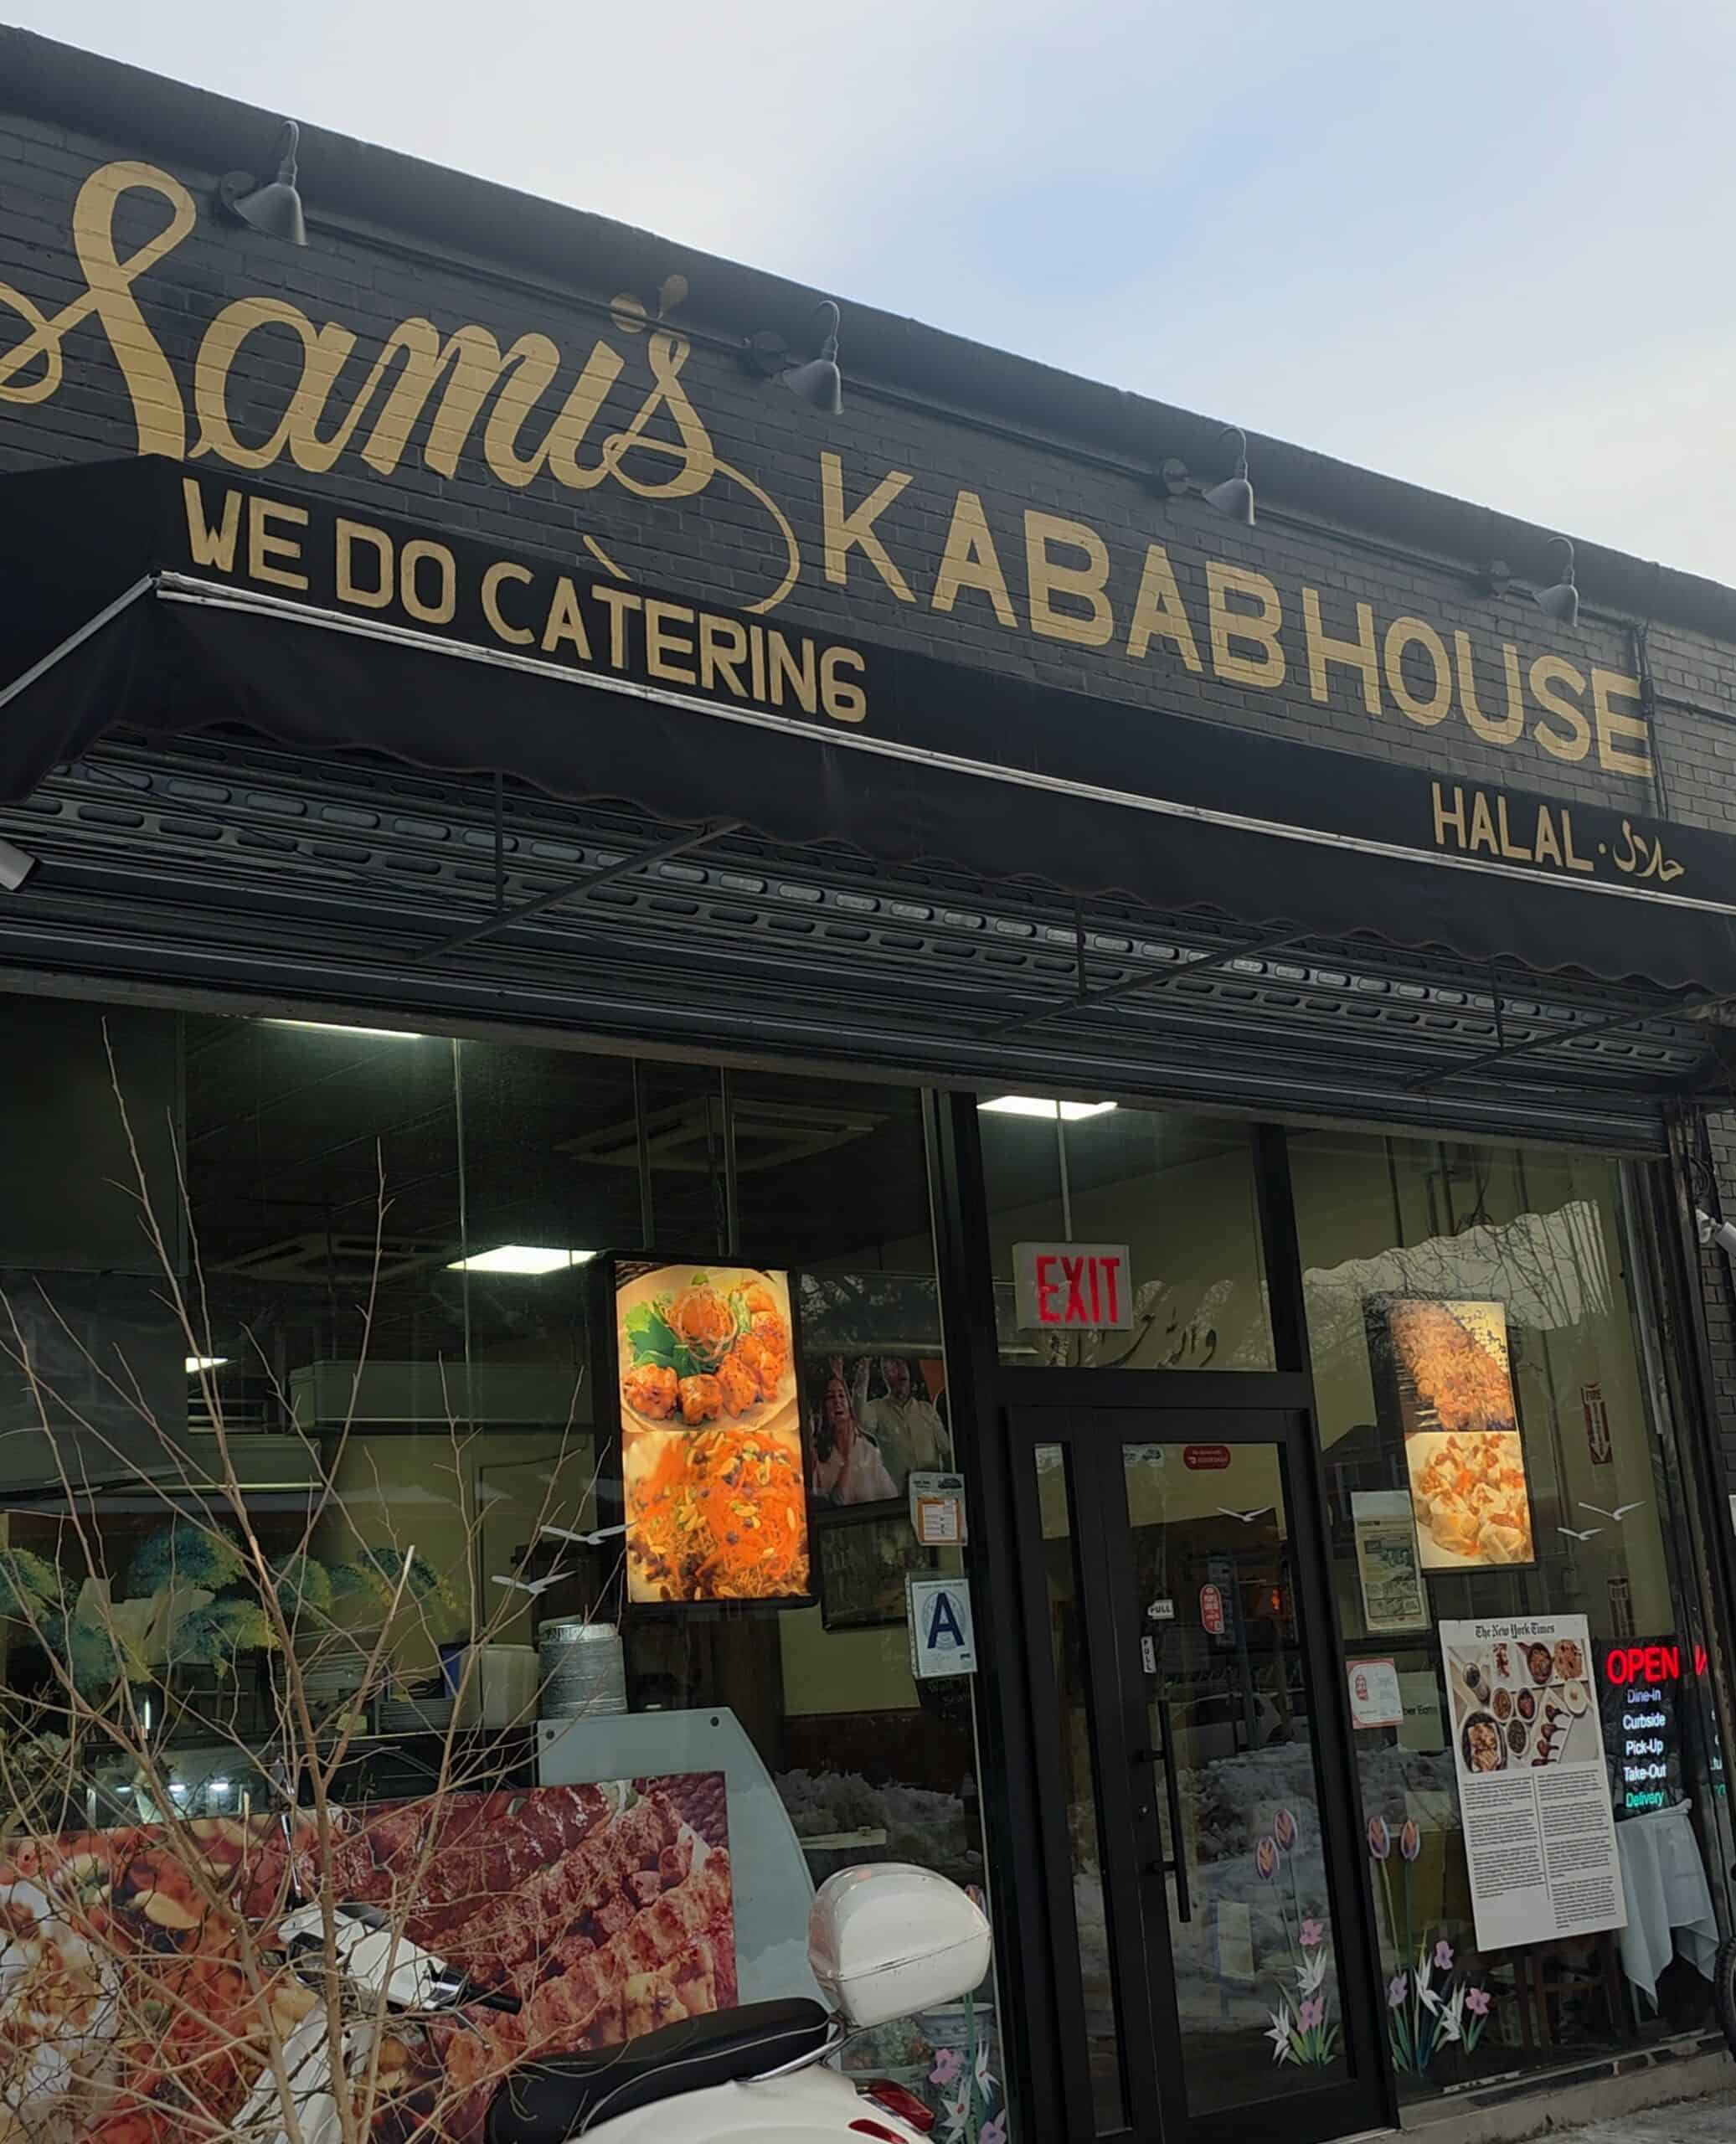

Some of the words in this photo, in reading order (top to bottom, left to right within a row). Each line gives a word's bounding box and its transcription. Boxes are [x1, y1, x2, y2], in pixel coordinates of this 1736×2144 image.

[182, 477, 310, 590] WE
[335, 517, 457, 624] DO
[820, 451, 1287, 690] KABAB
[1302, 587, 1656, 778] HOUSE
[1431, 781, 1594, 873] HALAL
[1036, 1255, 1120, 1324] EXIT
[927, 1592, 965, 1649] A
[1150, 1605, 1172, 1615] PULL
[1475, 1625, 1491, 1639] The
[1607, 1646, 1680, 1685] OPEN
[1622, 1711, 1666, 1730] Curbside
[1625, 1737, 1664, 1756] Pick-Up
[1622, 1763, 1666, 1782] Take-Out
[1625, 1790, 1665, 1809] Delivery
